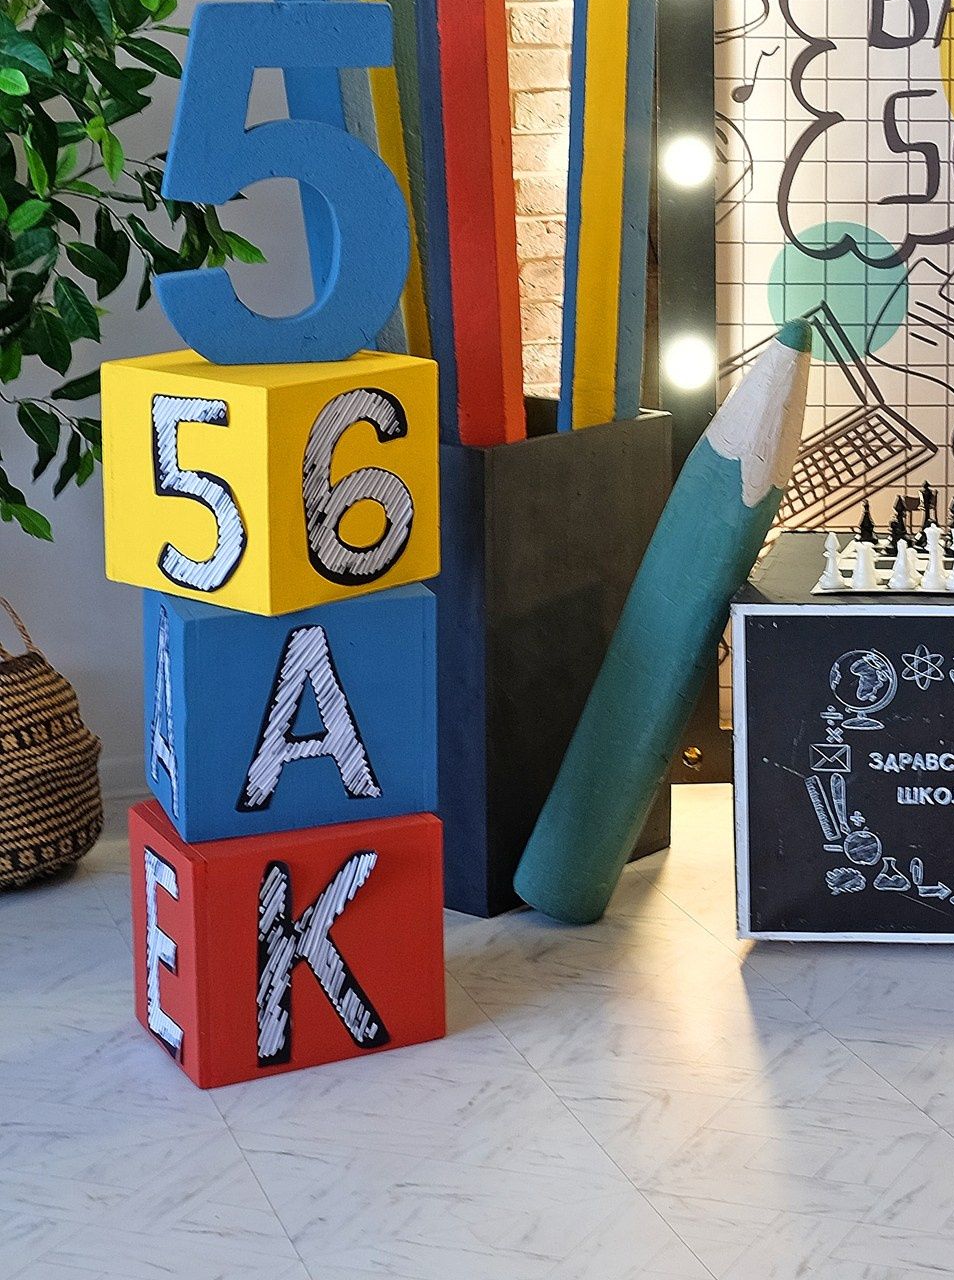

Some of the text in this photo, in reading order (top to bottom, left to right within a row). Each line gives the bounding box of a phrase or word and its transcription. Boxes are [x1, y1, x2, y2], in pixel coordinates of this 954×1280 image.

[153, 0, 412, 365] 5
[151, 393, 248, 592] 5
[303, 387, 415, 587] 6
